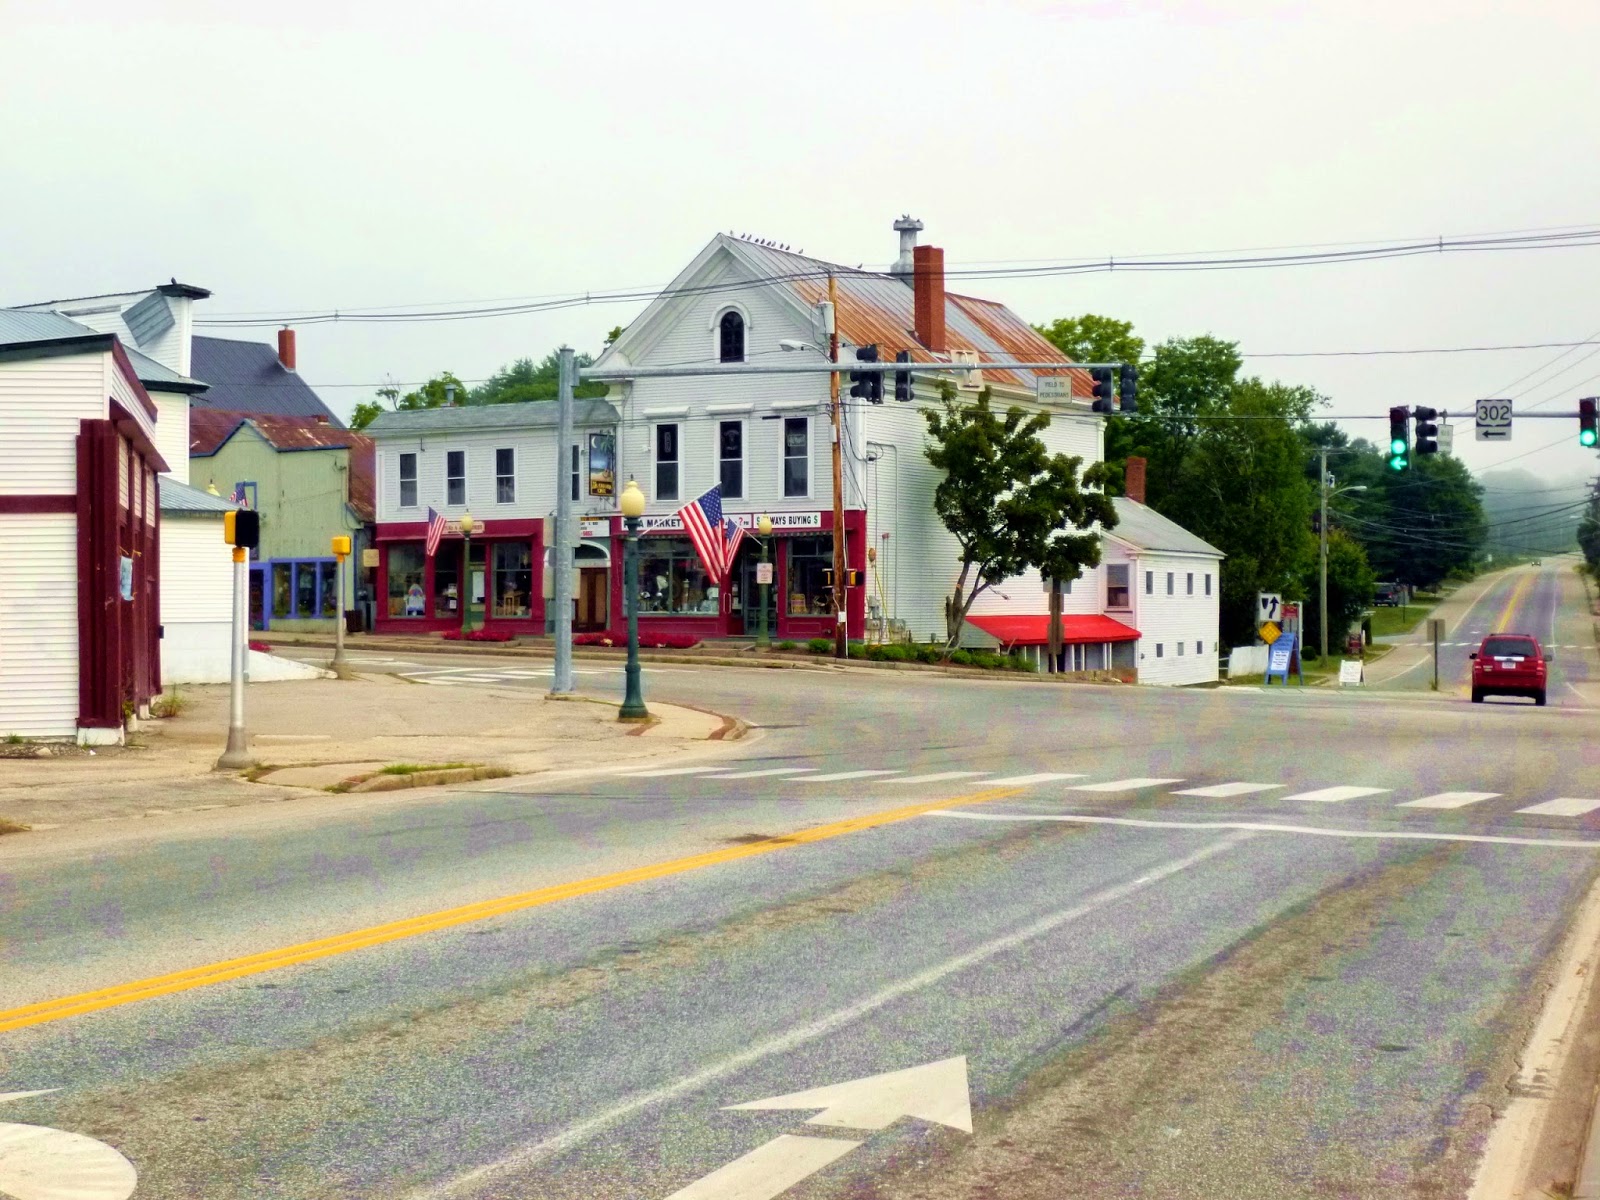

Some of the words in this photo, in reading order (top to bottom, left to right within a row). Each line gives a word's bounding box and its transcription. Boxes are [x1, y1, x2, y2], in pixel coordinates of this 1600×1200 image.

[1479, 405, 1510, 421] 302
[646, 518, 681, 528] MARKET
[788, 514, 812, 525] BUYING
